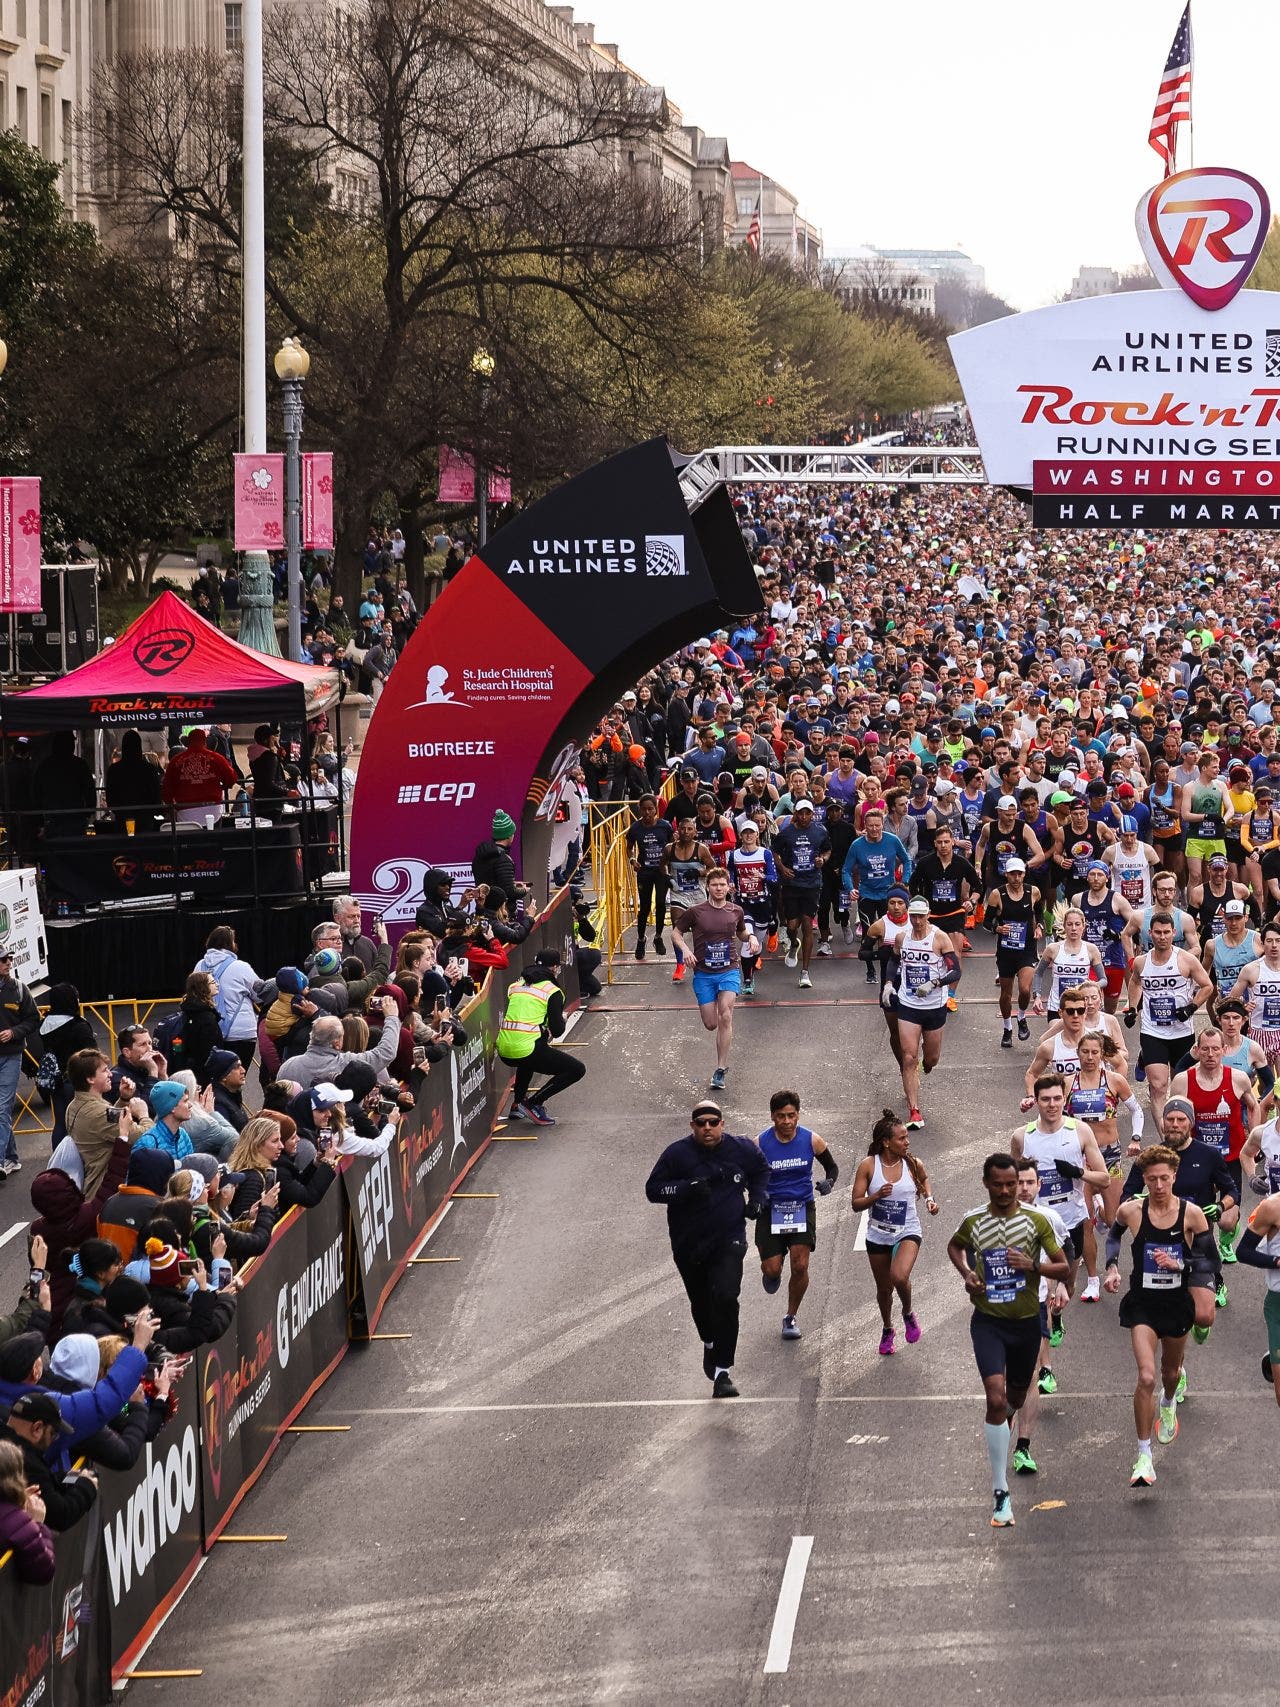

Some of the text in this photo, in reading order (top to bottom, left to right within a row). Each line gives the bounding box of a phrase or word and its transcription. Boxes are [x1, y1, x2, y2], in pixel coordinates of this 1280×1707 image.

[1125, 332, 1253, 350] UNITED
[1092, 355, 1253, 373] AIRLINES
[1057, 436, 1218, 456] RUNNING
[1059, 505, 1146, 521] HALF
[532, 539, 636, 555] UNITED
[507, 558, 637, 574] AIRLINES
[463, 668, 553, 681] St. Jude Children's
[463, 680, 554, 692] Research Hospital
[101, 711, 204, 722] RUNNING SERIES
[423, 782, 476, 807] cep
[901, 950, 930, 962] DOJO
[1056, 965, 1087, 975] DOJO
[1143, 979, 1178, 990] DOJO
[1086, 1102, 1093, 1110] 7
[1202, 1134, 1224, 1143] 1037
[1050, 1183, 1062, 1191] 45
[292, 1231, 345, 1341] ENDURANCE
[228, 1370, 272, 1443] RUNNING SERIES
[104, 1424, 197, 1608] wahoo
